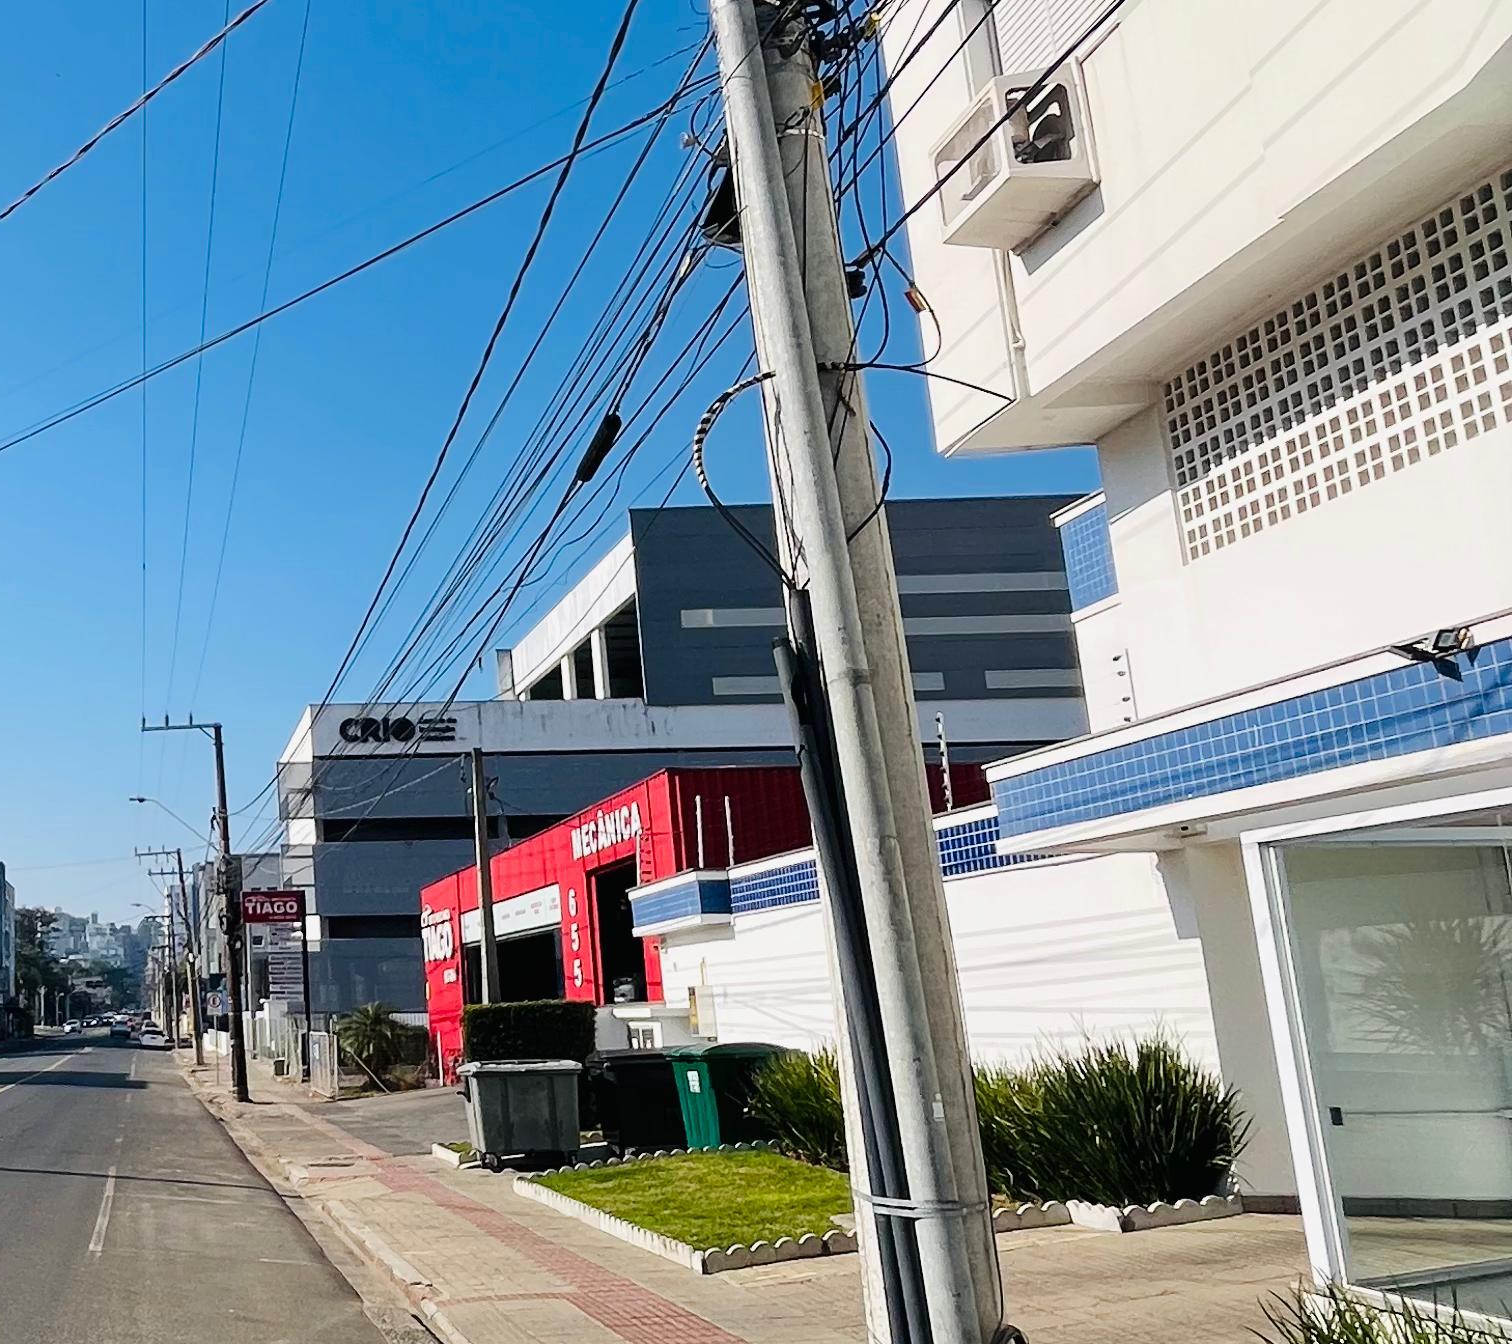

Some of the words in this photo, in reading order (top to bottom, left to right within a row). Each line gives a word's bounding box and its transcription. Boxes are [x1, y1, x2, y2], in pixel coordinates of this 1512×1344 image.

[571, 800, 643, 861] MECÂNICA
[245, 901, 298, 915] TIAGO
[421, 919, 453, 963] TIAGO
